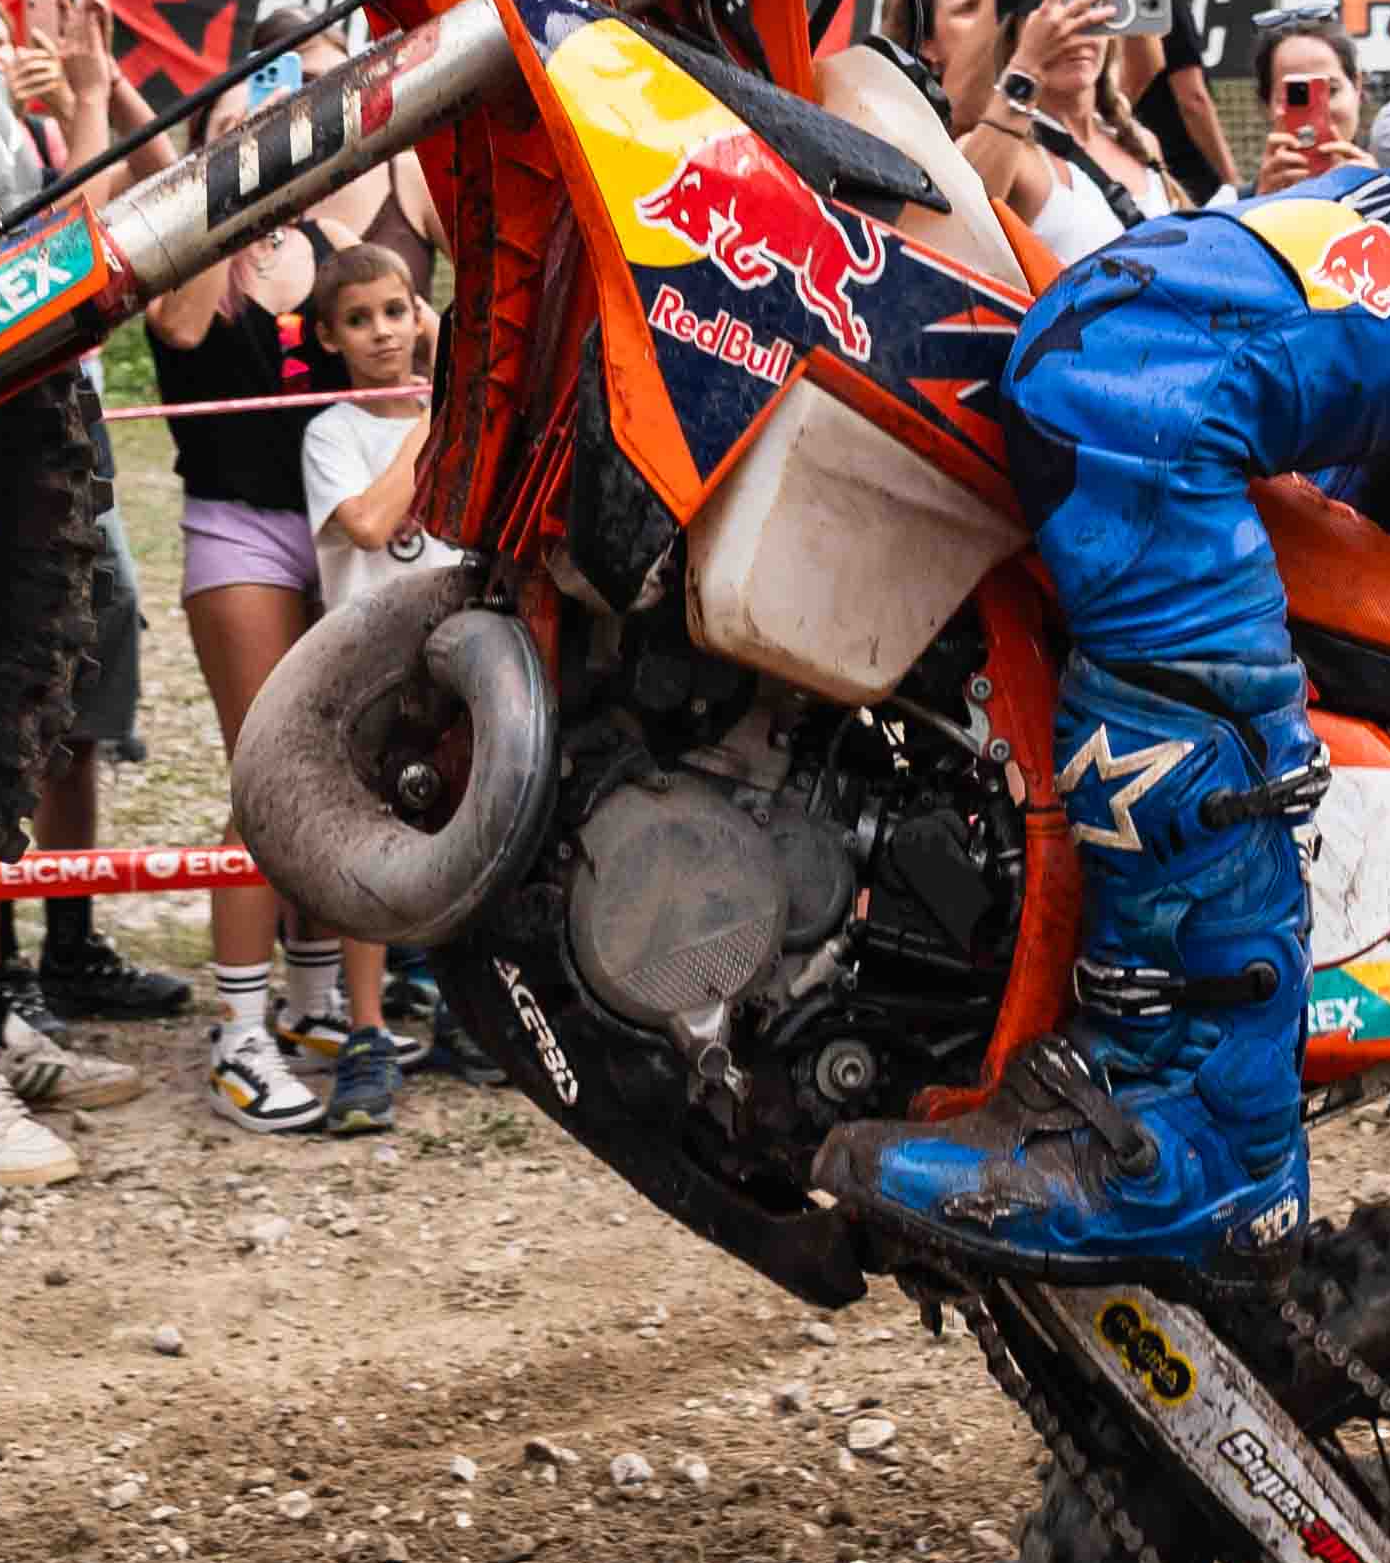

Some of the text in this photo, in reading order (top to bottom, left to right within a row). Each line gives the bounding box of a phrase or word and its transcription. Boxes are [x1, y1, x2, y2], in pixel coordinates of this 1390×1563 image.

[648, 284, 794, 385] Red Bull
[0, 855, 120, 885] EICMA
